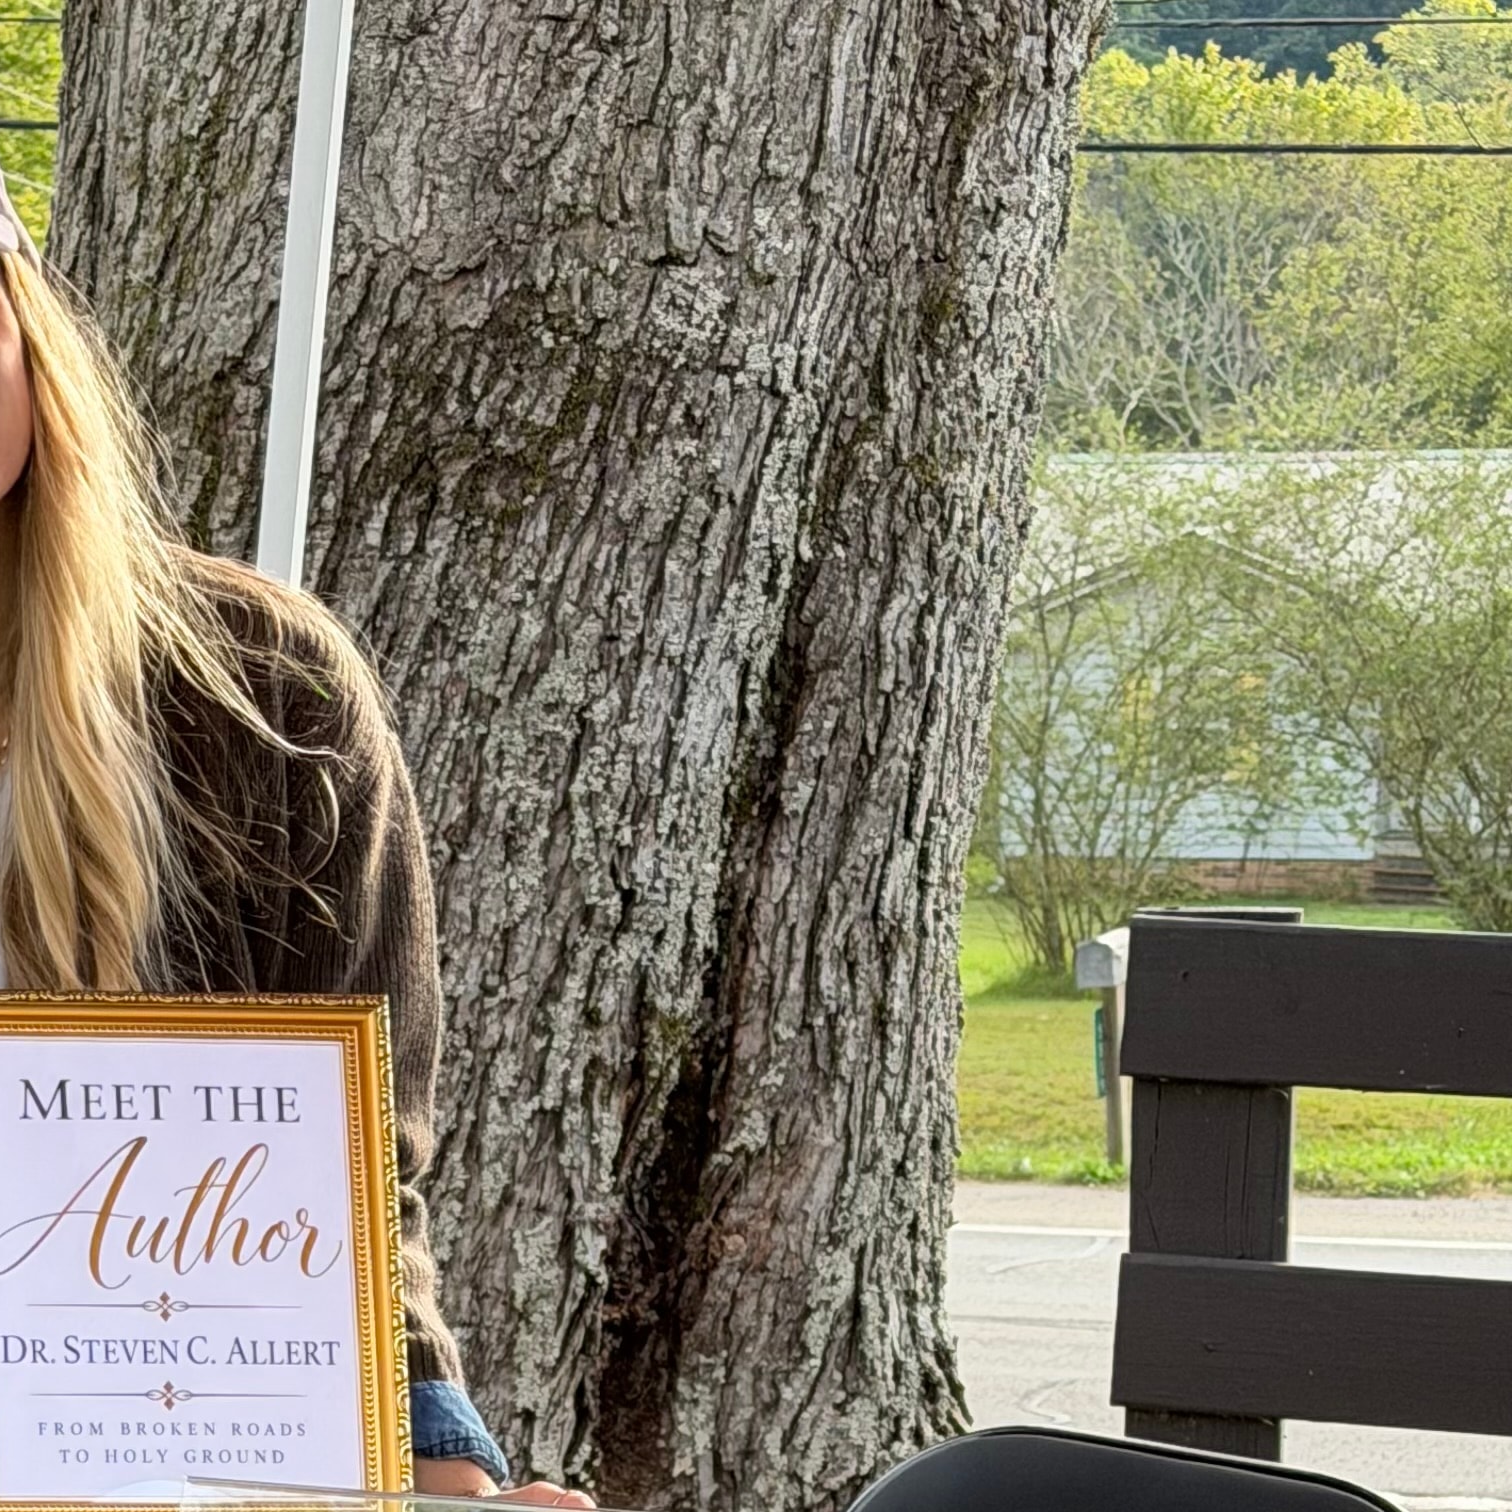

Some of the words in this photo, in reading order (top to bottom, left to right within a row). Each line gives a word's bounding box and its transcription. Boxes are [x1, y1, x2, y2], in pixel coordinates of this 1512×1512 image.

[19, 1078, 171, 1120] MEET
[193, 1085, 301, 1122] THE
[187, 1336, 216, 1365] C.
[38, 1422, 104, 1437] FROM
[121, 1422, 216, 1437] BROKEN
[231, 1422, 307, 1437] ROADS
[59, 1450, 89, 1464] TO
[105, 1450, 169, 1464] HOLY
[184, 1450, 285, 1465] GROUND
